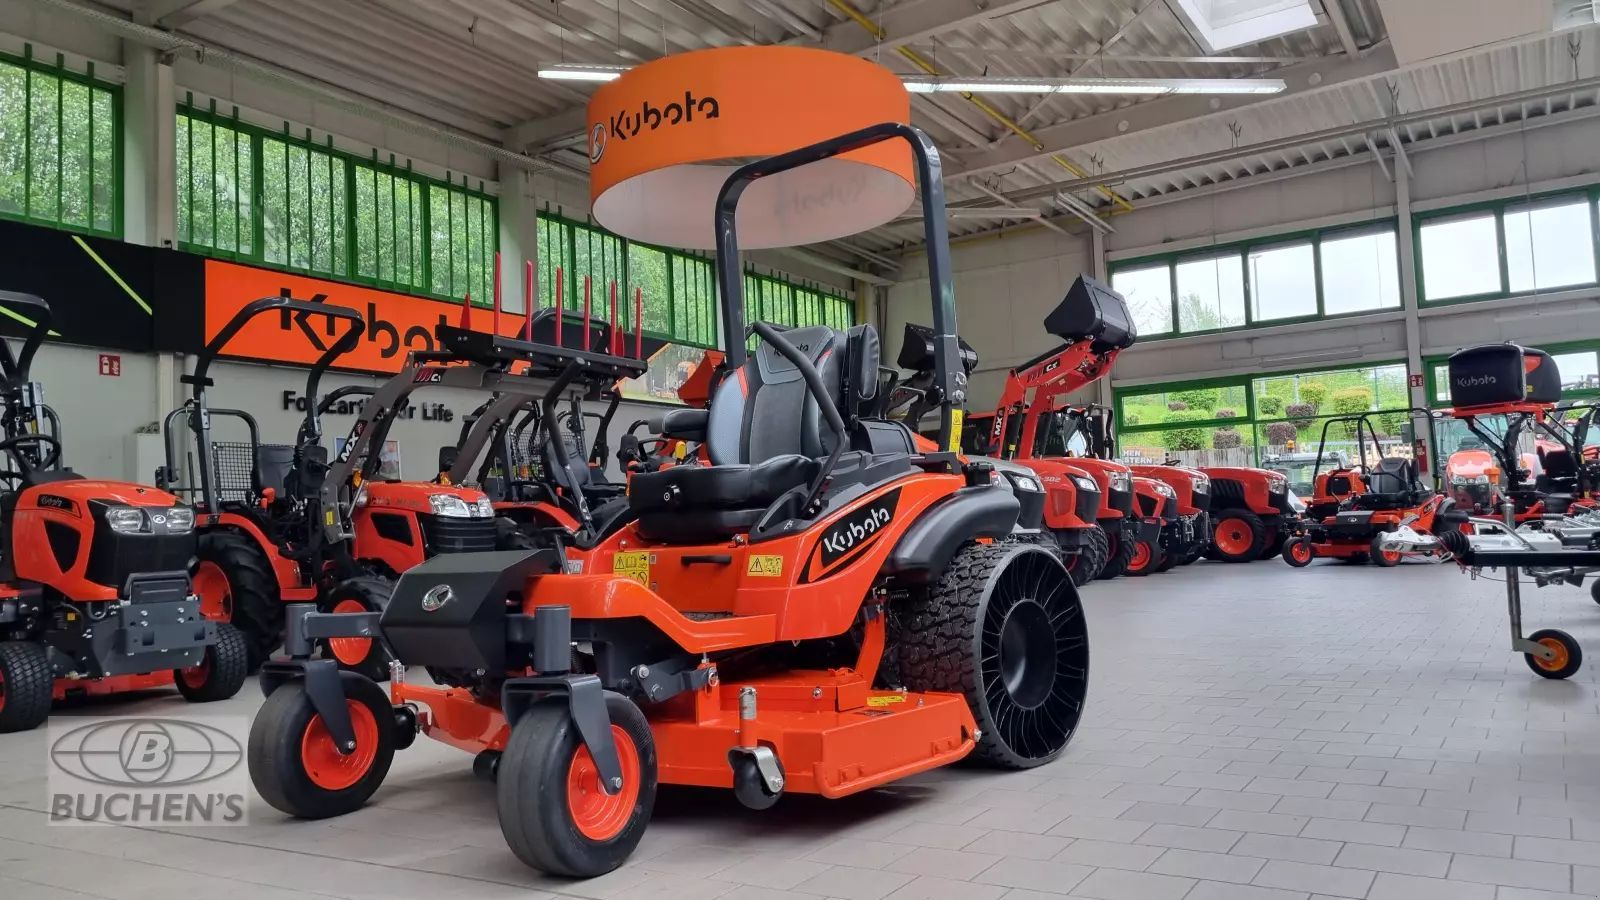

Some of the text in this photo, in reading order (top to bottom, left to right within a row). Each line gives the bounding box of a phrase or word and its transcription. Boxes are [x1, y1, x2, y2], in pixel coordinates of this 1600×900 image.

[610, 91, 719, 141] Kubota
[280, 288, 448, 366] Kbo
[1457, 375, 1497, 387] Kubota
[283, 390, 307, 411] Fo
[422, 402, 453, 422] Life
[994, 416, 1003, 435] MX
[341, 431, 359, 462] MX
[823, 508, 890, 553] Kubota
